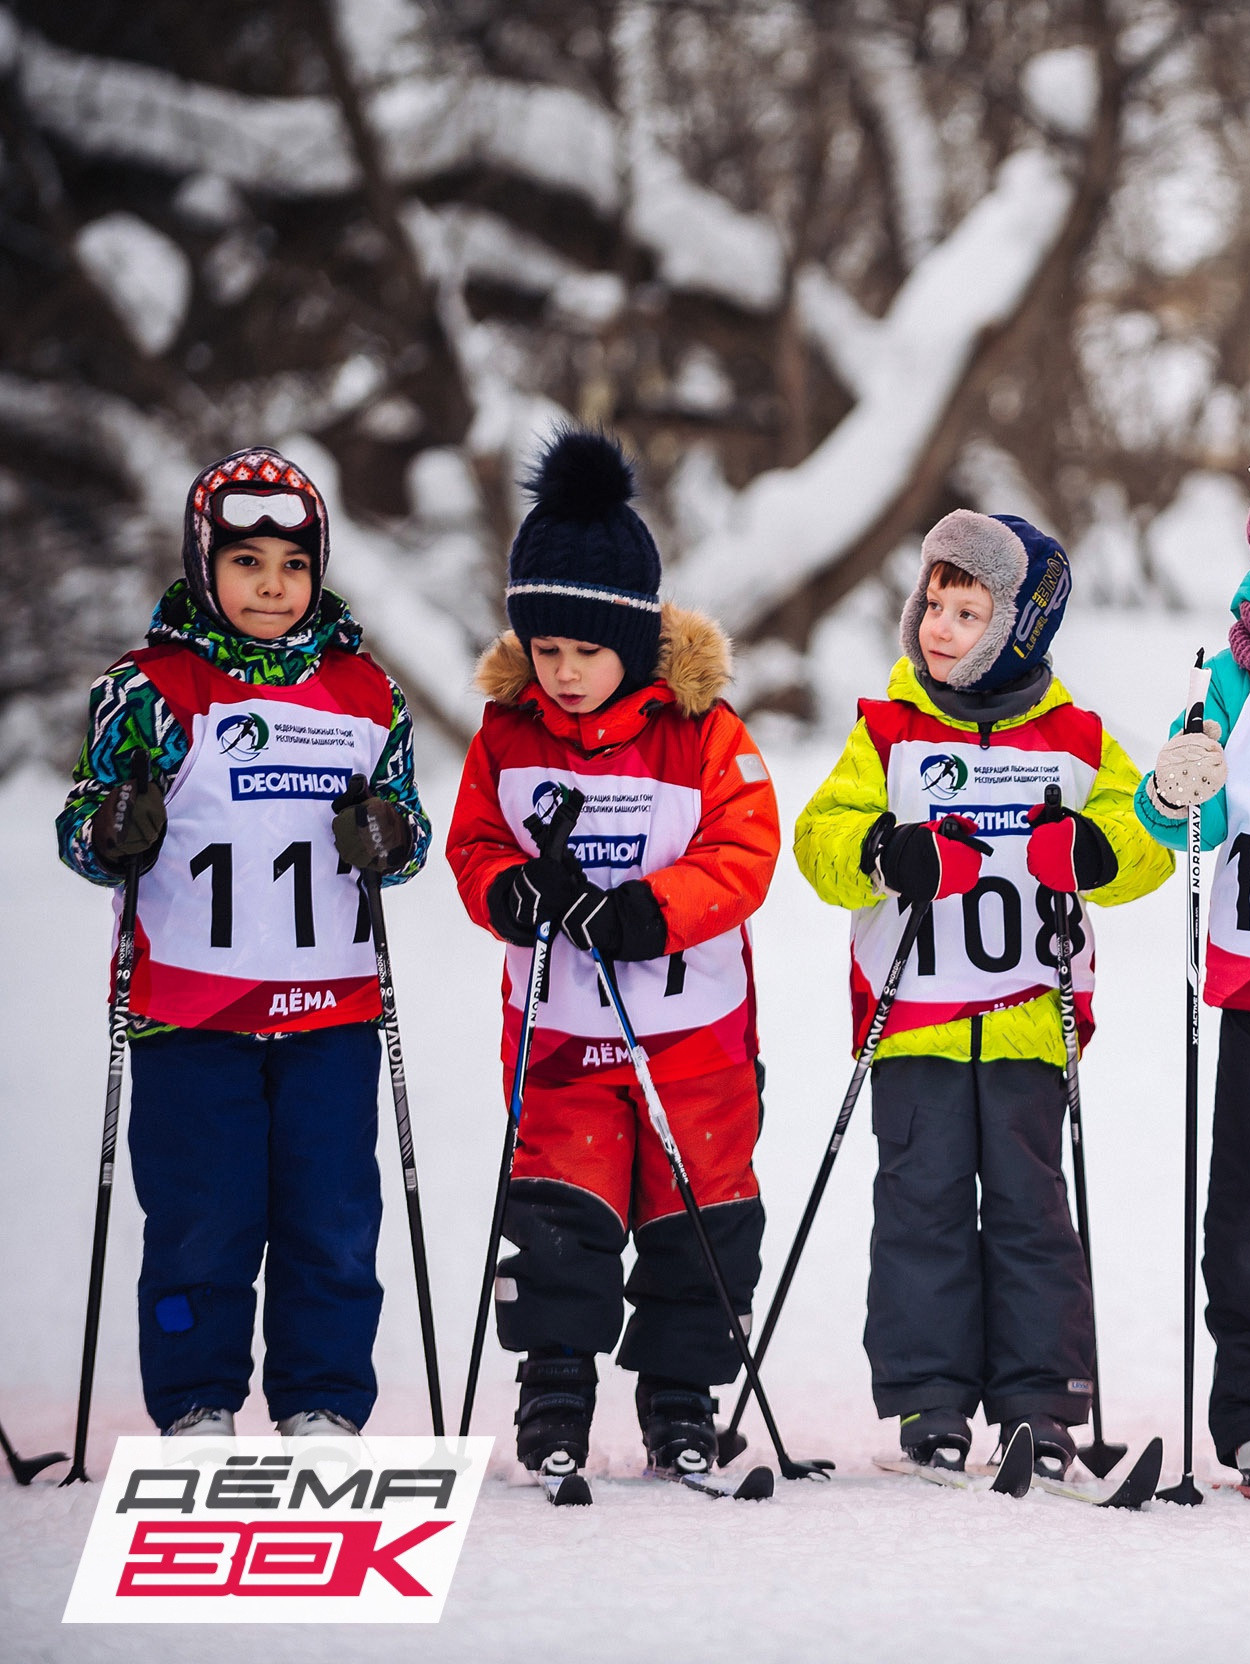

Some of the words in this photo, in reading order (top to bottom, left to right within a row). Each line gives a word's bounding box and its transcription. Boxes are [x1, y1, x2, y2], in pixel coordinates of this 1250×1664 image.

[237, 772, 347, 794] DECATHLON
[974, 766, 1010, 774] ФЕДЕРАЦИЯ
[1010, 765, 1039, 773] ЛЫЖНЫХ
[974, 775, 1013, 783] РЕСПУБЛИКИ
[1013, 775, 1061, 783] БАШКОРТОСТАН
[1192, 811, 1201, 888] NORDWAY
[116, 969, 131, 981] 90
[530, 948, 547, 1022] NORDWAY
[268, 987, 337, 1016] ДЁМА
[1060, 980, 1077, 1053] INOVIK
[110, 989, 130, 1076] INOVIK
[384, 1005, 406, 1088] INOVIK
